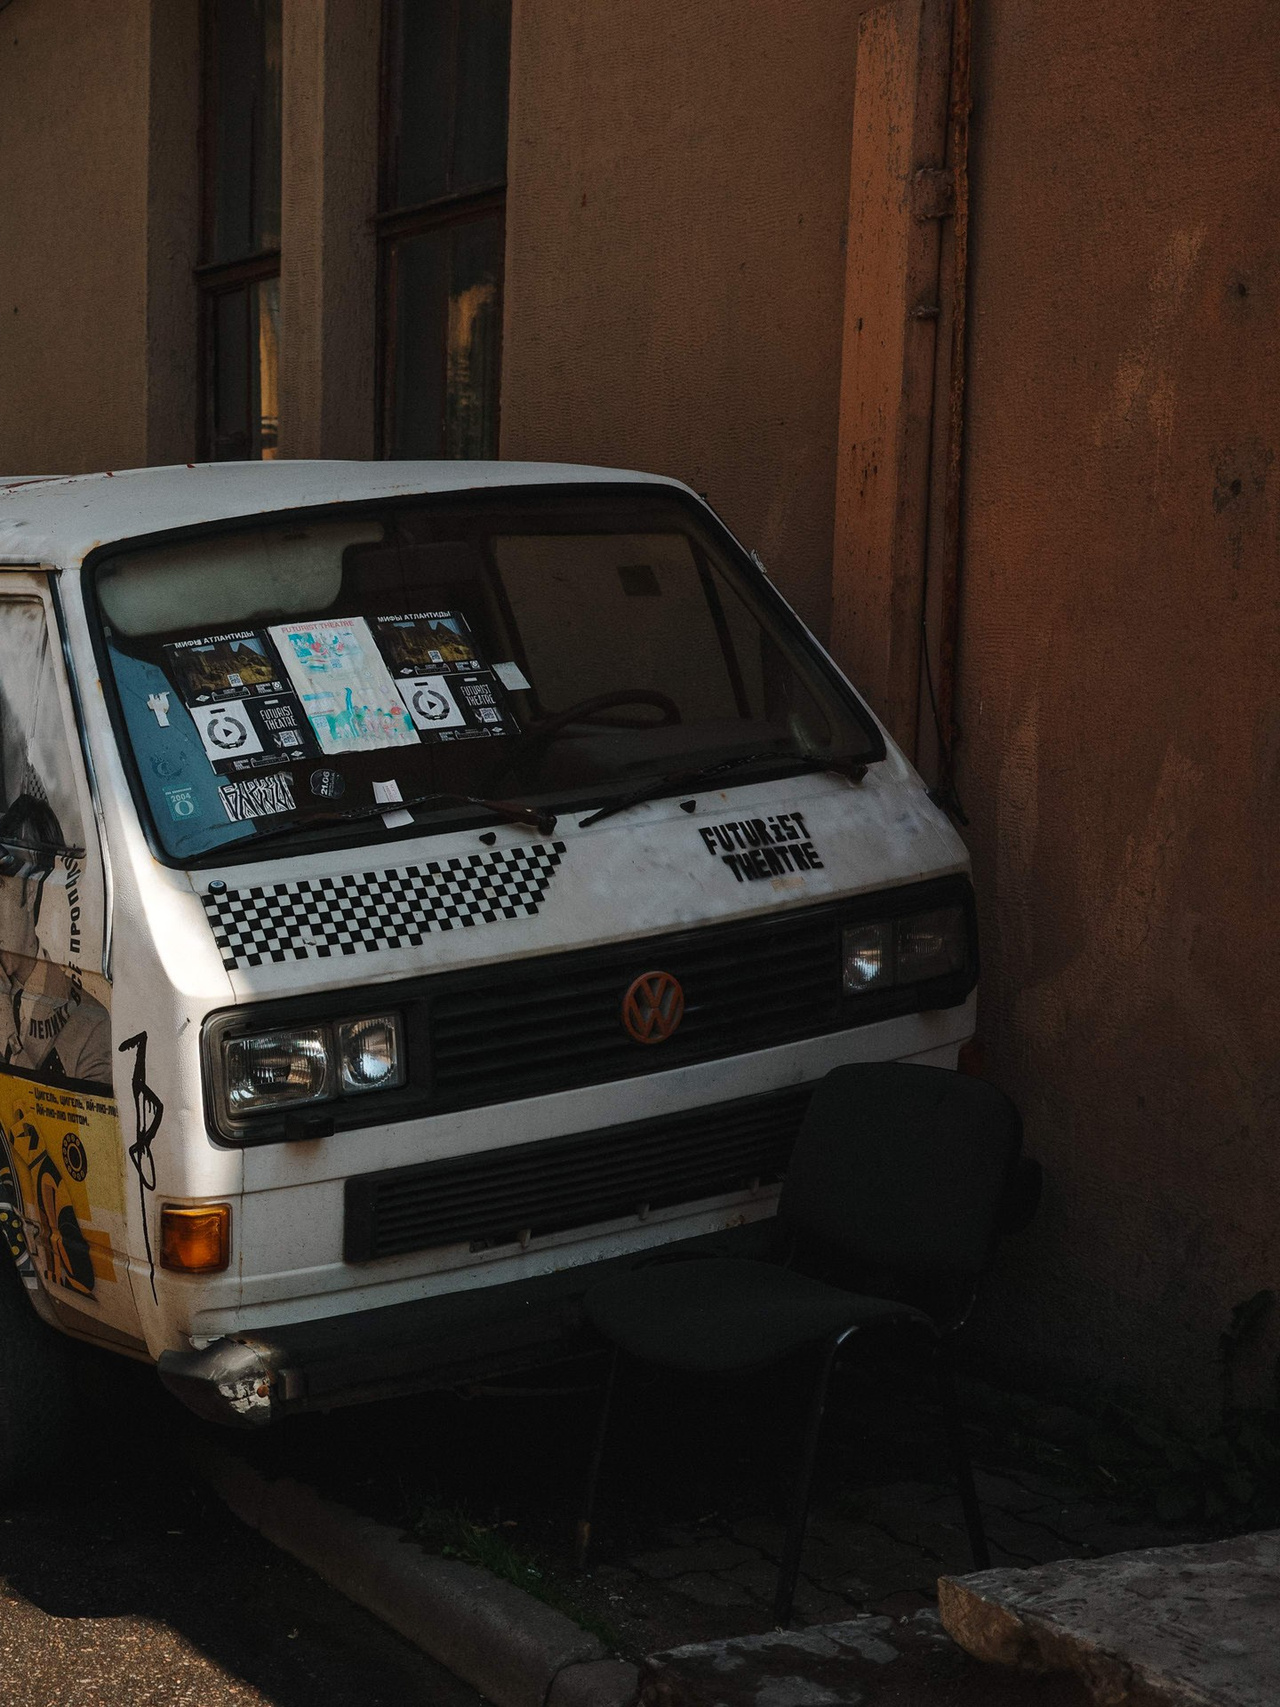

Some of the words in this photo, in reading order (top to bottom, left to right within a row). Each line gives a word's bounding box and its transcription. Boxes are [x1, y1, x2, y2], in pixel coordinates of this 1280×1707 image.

[377, 614, 403, 623] МИФЫ
[404, 610, 451, 621] АТЛАНТИДЫ
[174, 639, 202, 649] МИФЫ
[202, 630, 255, 645] АТЛАНТИДЫ
[460, 683, 491, 697] FUTURIST
[465, 693, 496, 707] THEATRE
[259, 705, 293, 720] FUTURIST
[264, 715, 298, 731] THEATRE
[170, 792, 192, 803] 2004
[69, 960, 83, 1007] ВСЕ
